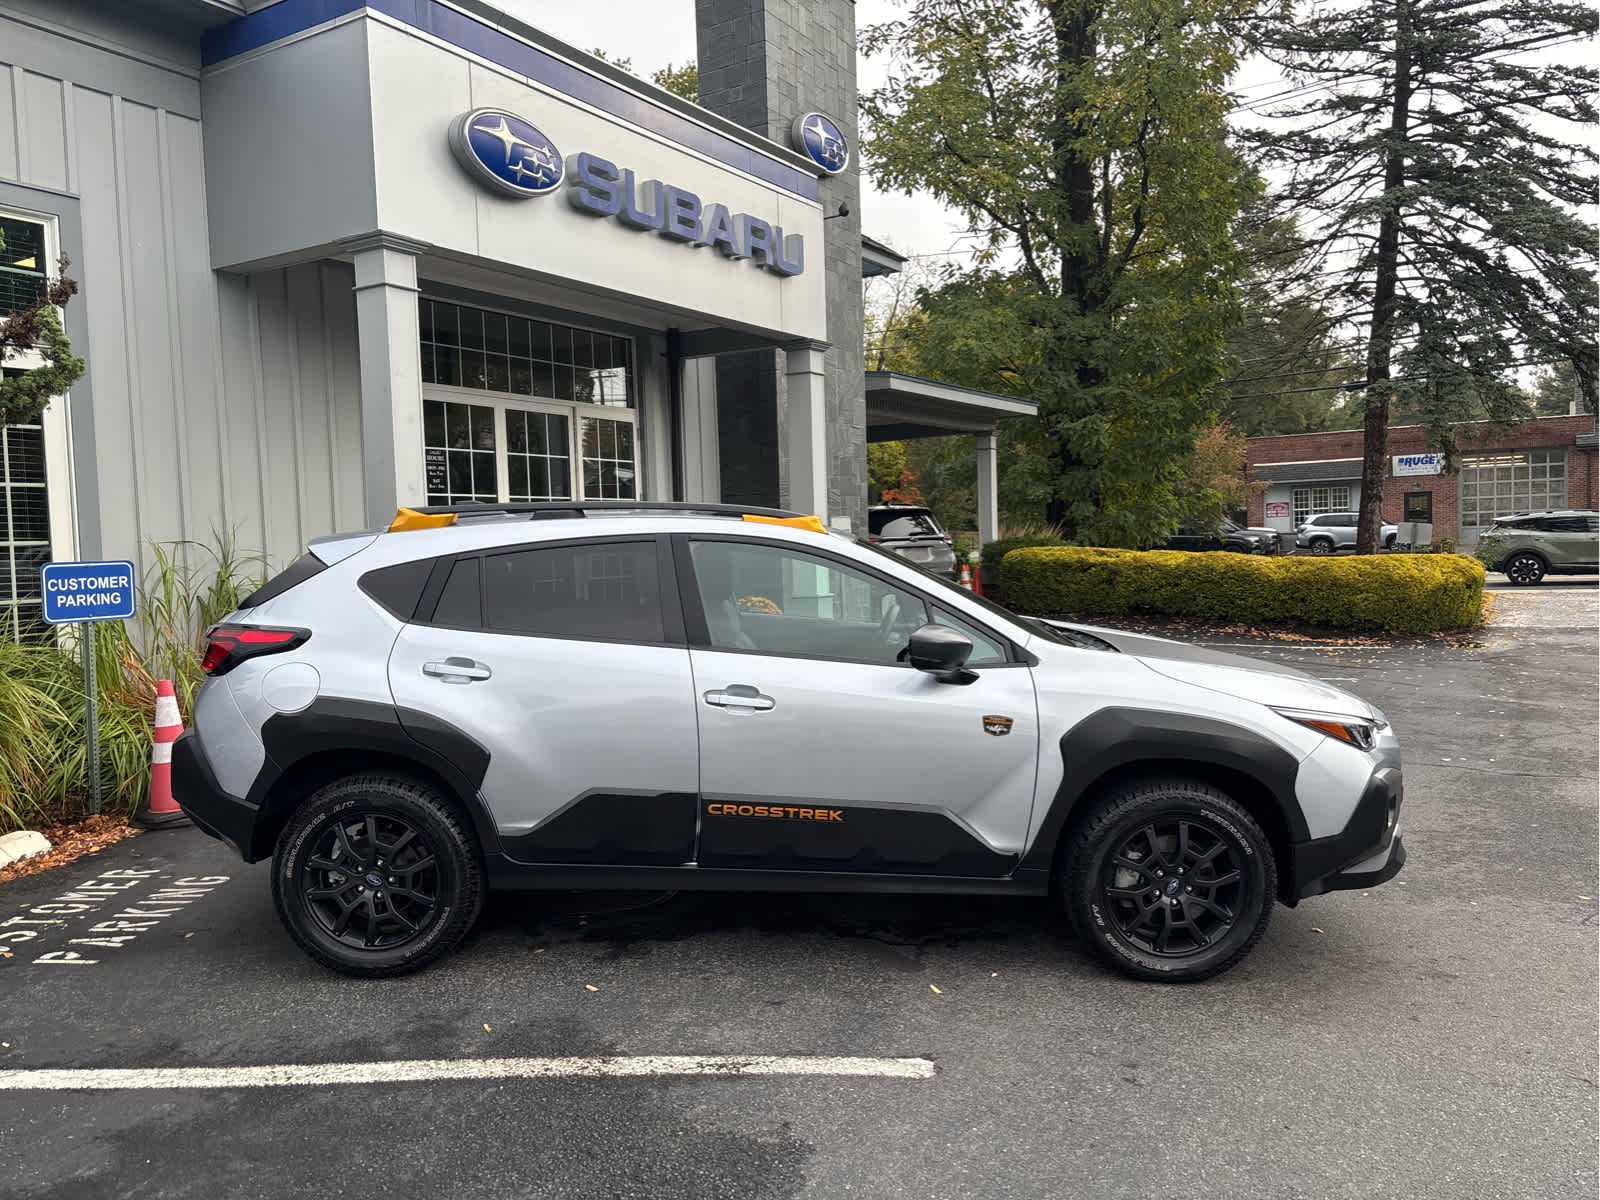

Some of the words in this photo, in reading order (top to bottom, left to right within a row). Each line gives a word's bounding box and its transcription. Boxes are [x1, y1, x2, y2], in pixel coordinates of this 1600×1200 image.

[567, 152, 804, 277] SUBARU
[47, 576, 129, 592] CUSTOMER
[57, 592, 121, 608] PARKING
[707, 803, 844, 822] CROSSTREK
[32, 876, 230, 964] PARKING
